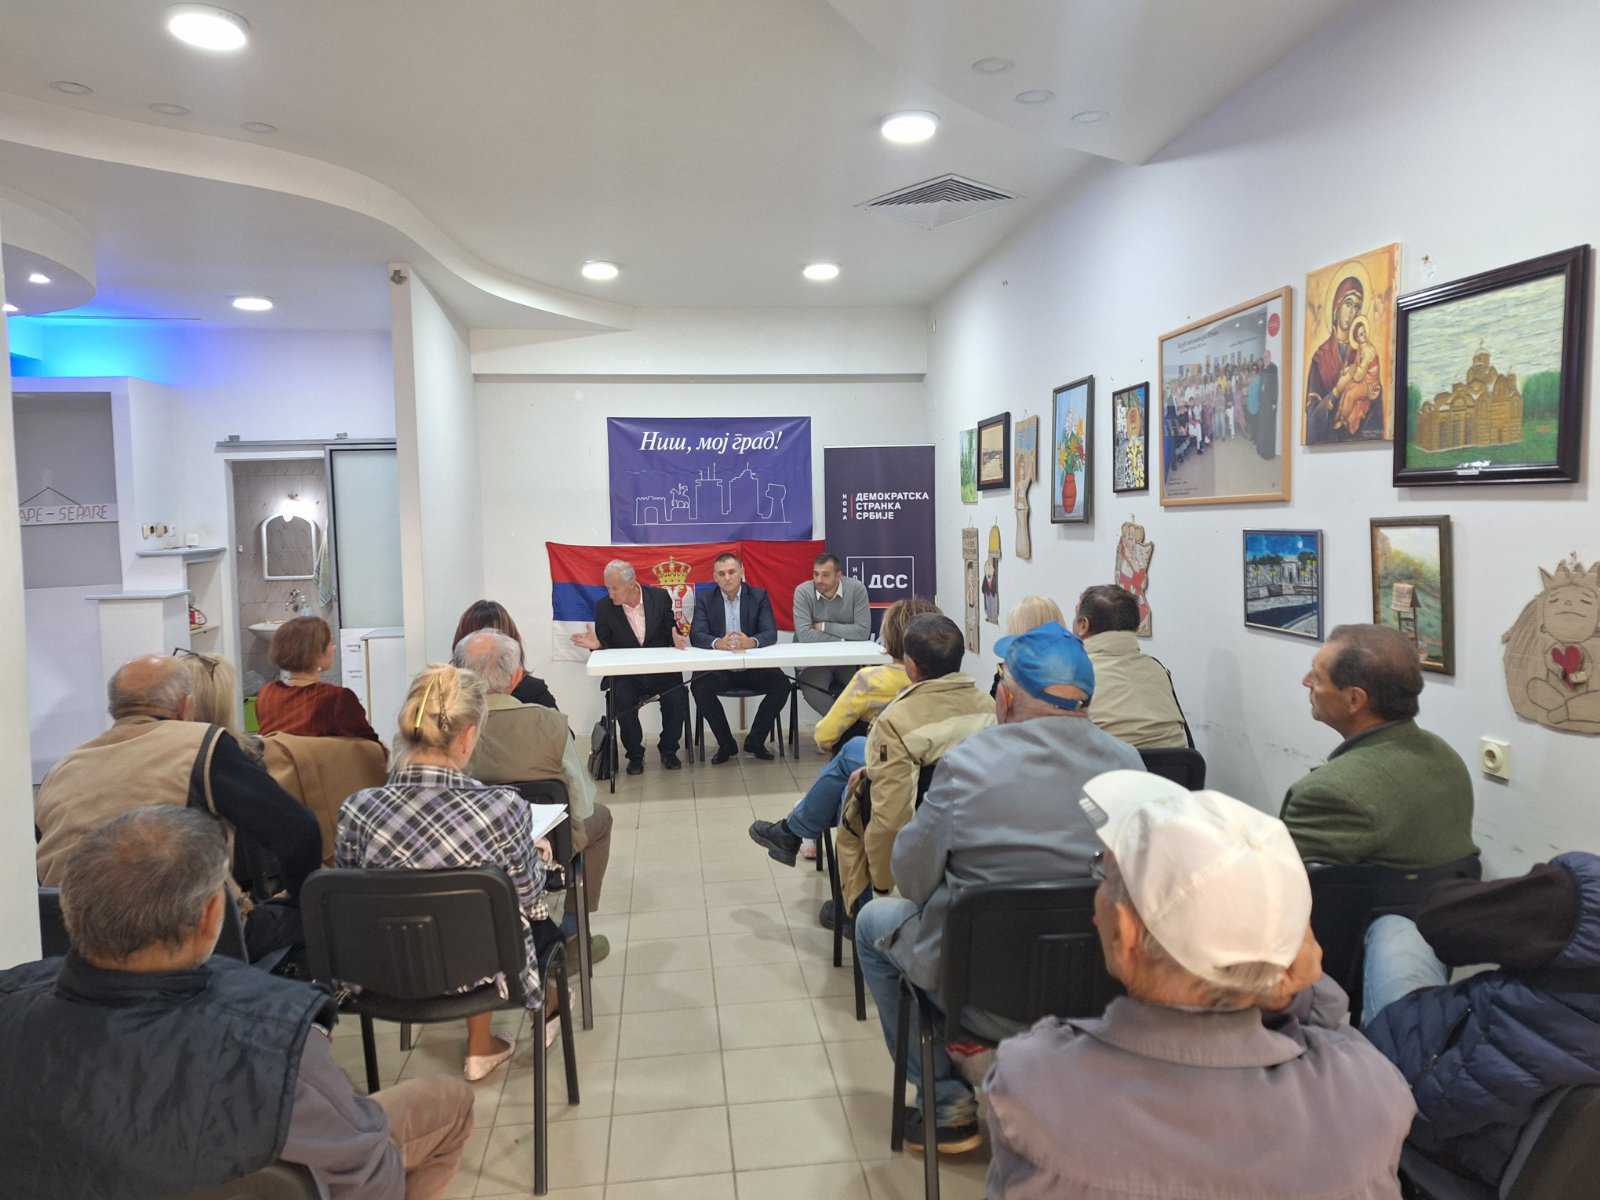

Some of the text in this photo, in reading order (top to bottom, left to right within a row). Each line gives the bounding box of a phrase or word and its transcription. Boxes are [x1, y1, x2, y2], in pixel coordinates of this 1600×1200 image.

[639, 431, 692, 454] Ниш,
[695, 432, 730, 455] мој
[855, 491, 930, 502] ДЕМОКРАТСКА
[855, 502, 902, 511] СТРАНКА
[855, 511, 896, 521] СРБИЈЕ
[868, 574, 908, 589] ДСС
